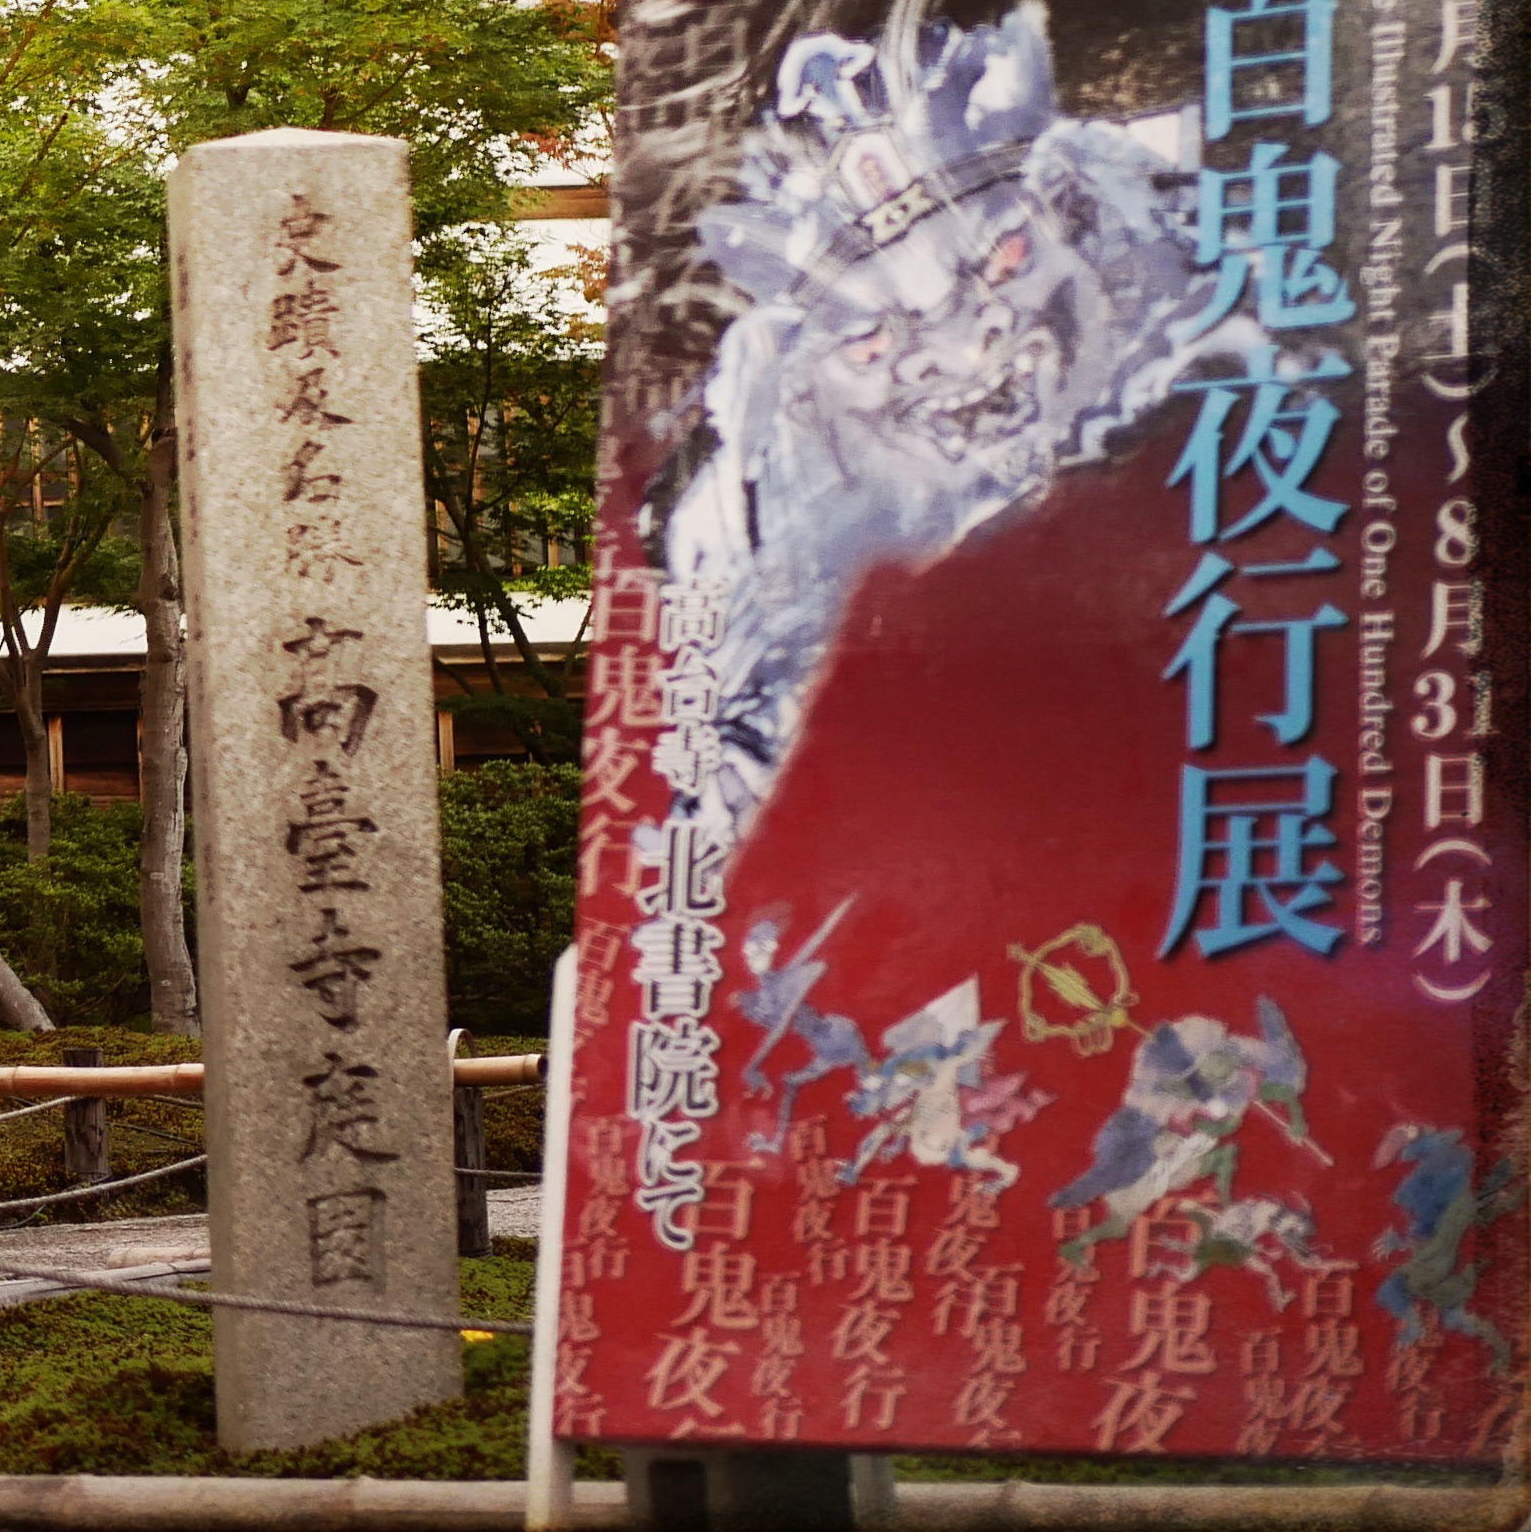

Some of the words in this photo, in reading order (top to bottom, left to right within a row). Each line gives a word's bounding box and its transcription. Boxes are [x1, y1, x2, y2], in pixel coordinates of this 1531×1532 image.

[1368, 21, 1407, 210] Illustrated
[1361, 215, 1402, 325] Night
[1361, 331, 1401, 461] Parade
[1359, 468, 1398, 511] of
[1359, 520, 1397, 600] One
[652, 576, 727, 797] 高台寺
[1357, 610, 1396, 774] Hundred
[1355, 785, 1394, 948] Demons
[790, 1114, 851, 1286] 百鬼夜行
[926, 1168, 1000, 1336] 鬼夜行
[643, 1156, 760, 1439] 百鬼夜
[752, 1270, 806, 1440] 百鬼夜行
[832, 1174, 919, 1431] 百鬼夜行
